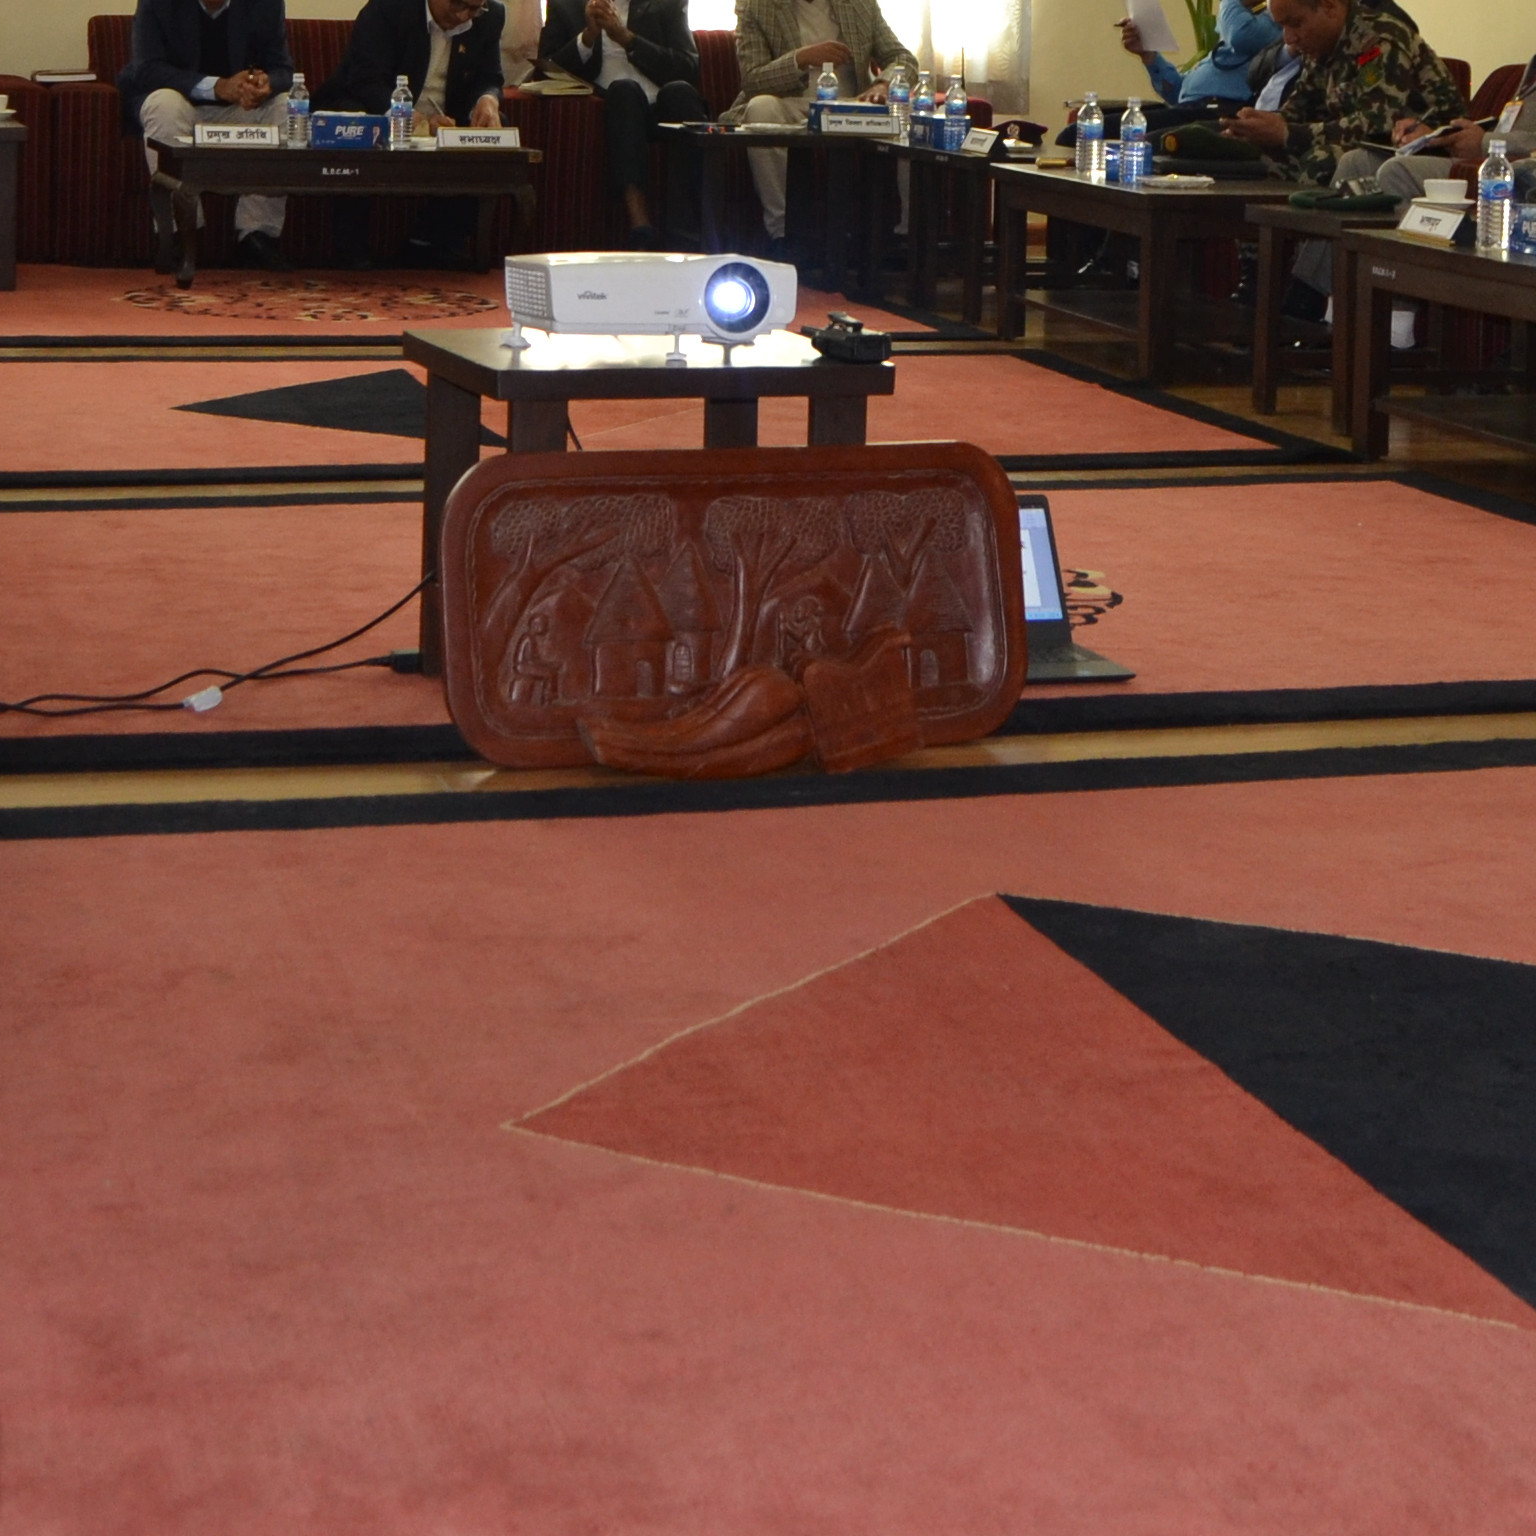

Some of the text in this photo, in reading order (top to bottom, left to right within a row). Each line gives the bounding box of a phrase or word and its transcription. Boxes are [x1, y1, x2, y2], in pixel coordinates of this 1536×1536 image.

[206, 128, 268, 142] प्रमुख अतिथि
[334, 125, 365, 137] PURE
